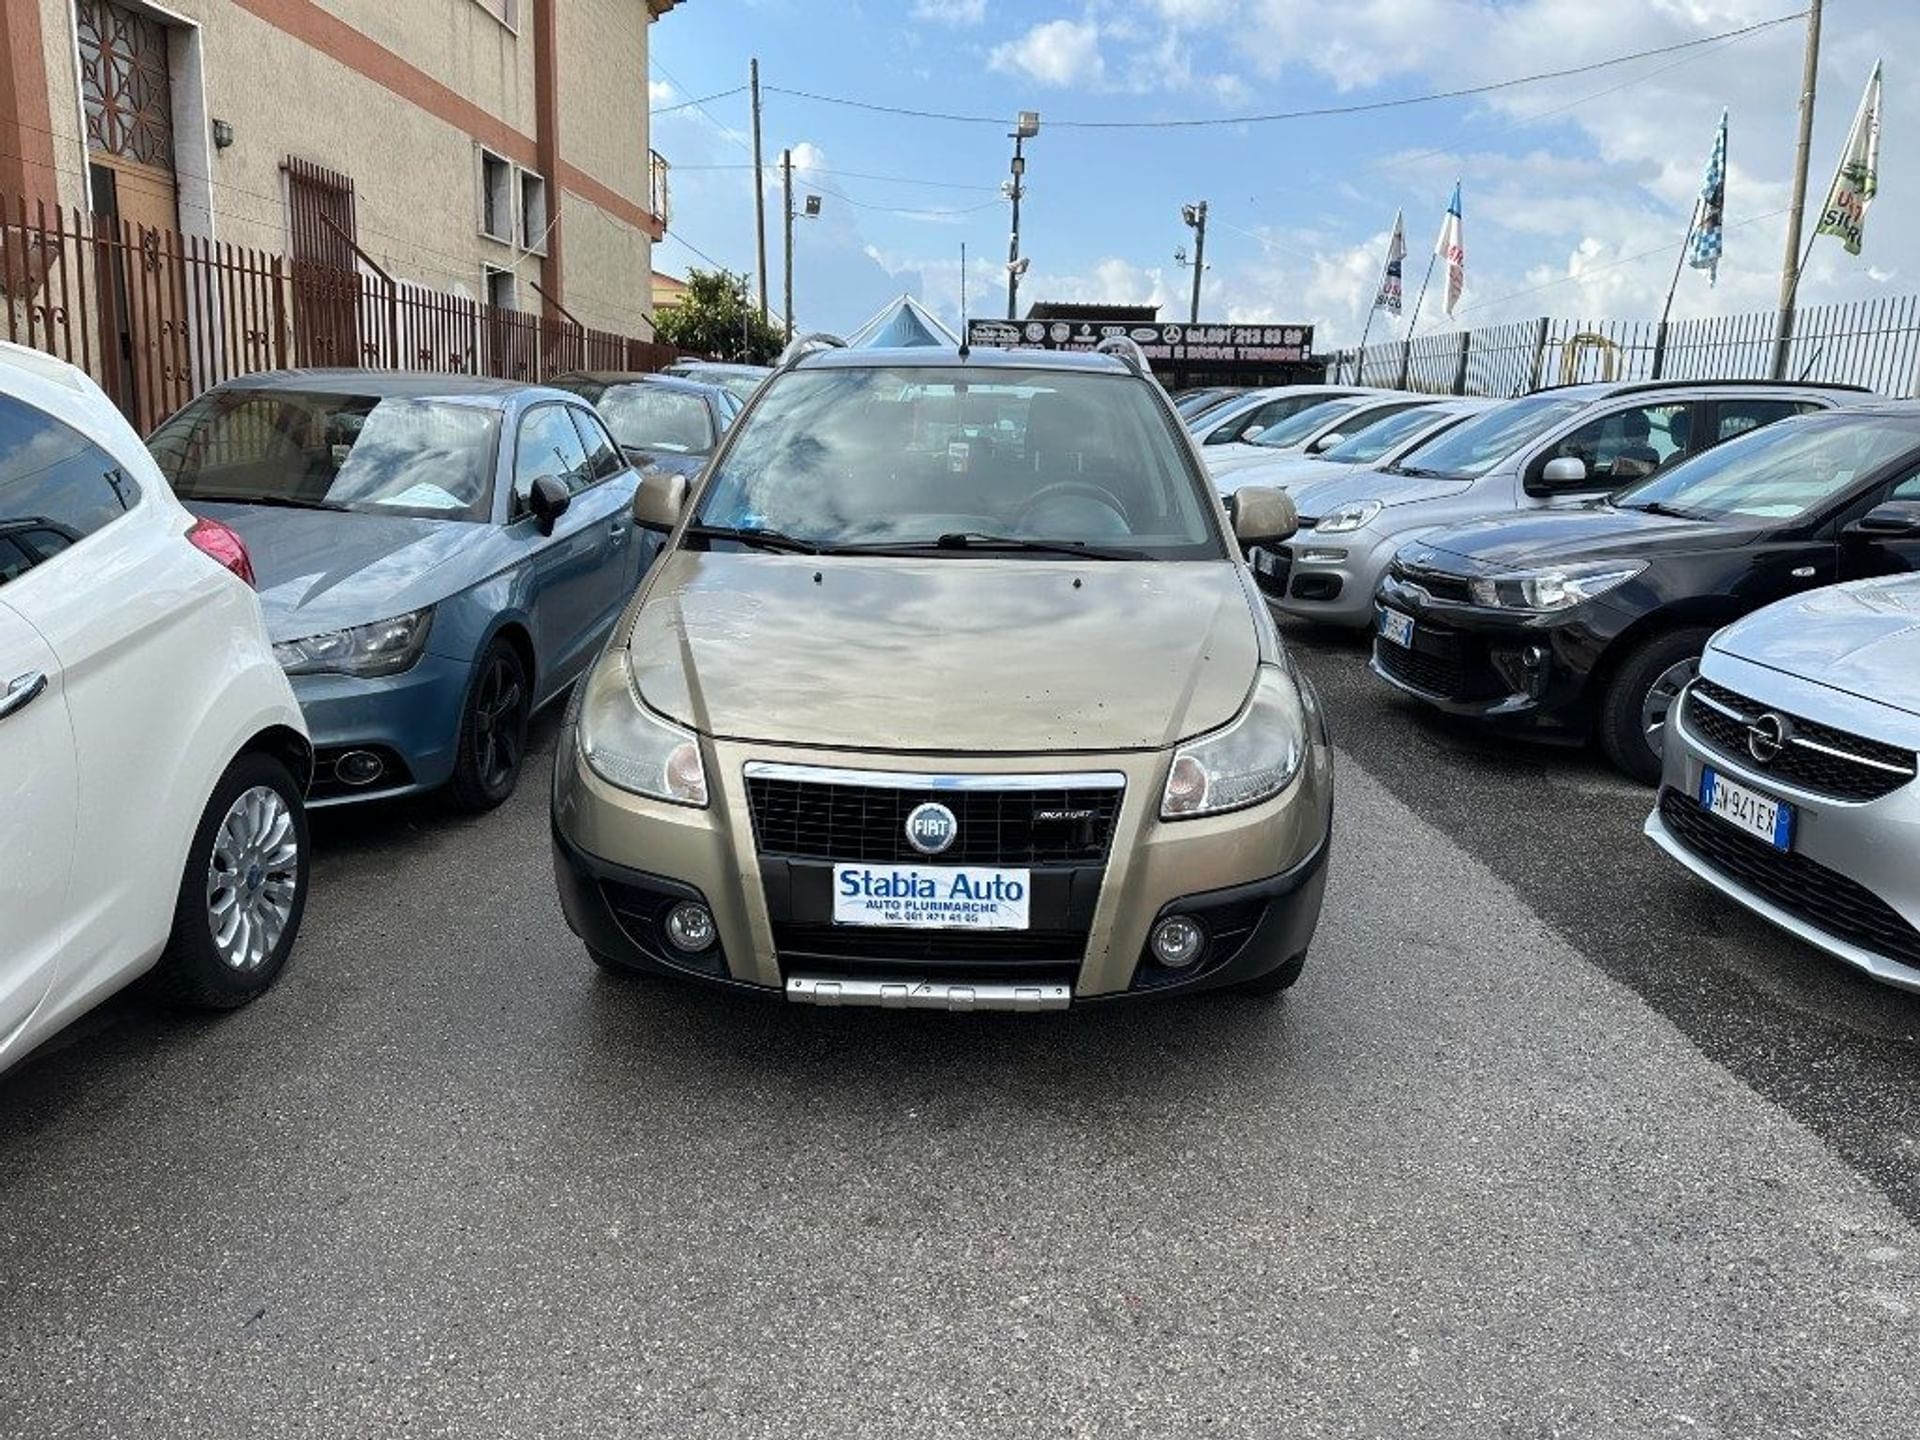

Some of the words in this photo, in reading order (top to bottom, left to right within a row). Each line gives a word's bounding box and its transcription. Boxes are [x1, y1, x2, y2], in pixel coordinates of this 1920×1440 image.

[914, 819, 948, 836] FIAT
[839, 870, 936, 899] Stabia
[949, 873, 1024, 901] Auto
[865, 900, 901, 910] AUTO
[904, 900, 998, 913] PLURIMARCHE
